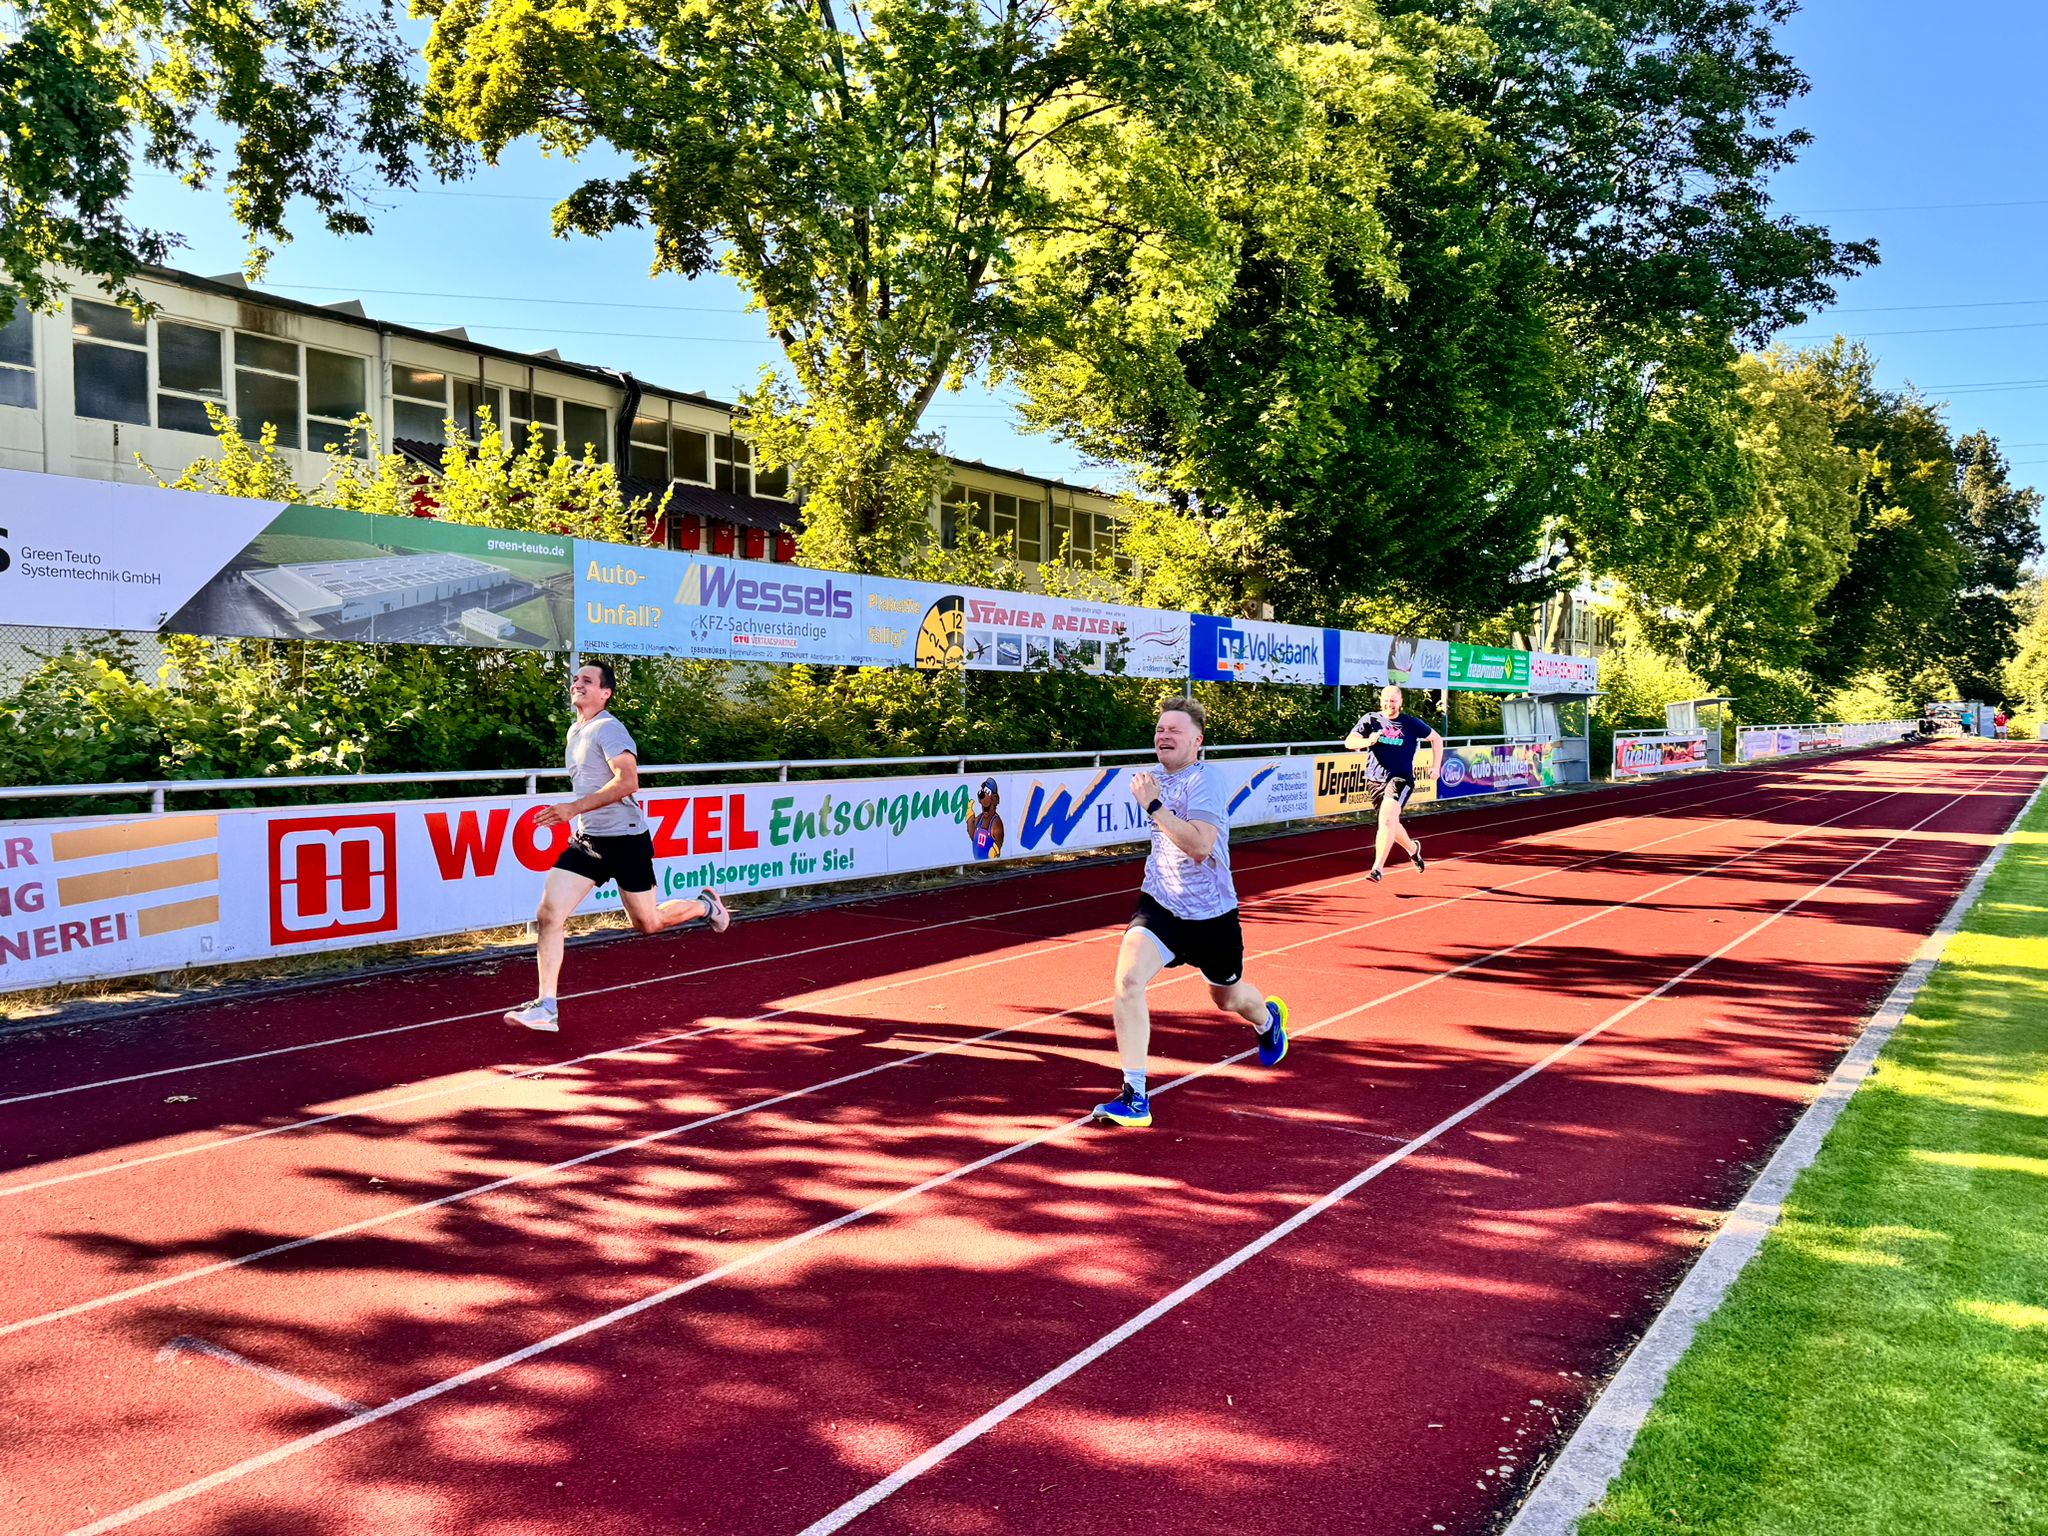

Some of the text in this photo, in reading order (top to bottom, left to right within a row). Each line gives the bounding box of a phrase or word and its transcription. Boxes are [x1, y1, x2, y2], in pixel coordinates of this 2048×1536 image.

[21, 546, 101, 565] Green Teuto
[487, 538, 565, 557] green-teuto.de
[21, 562, 161, 585] Systemtechnik GmbH
[586, 560, 646, 587] Auto-
[700, 564, 853, 619] Wessels
[868, 593, 921, 615] Plakette
[586, 601, 663, 628] Unfall?
[952, 612, 963, 629] 12
[967, 599, 1126, 635] STRIER REISEN
[700, 614, 827, 641] KFZ-Sachverständige
[584, 640, 609, 649] RHEINE
[751, 636, 797, 647] VERTRAGSPARTNER
[929, 633, 940, 648] 2
[1247, 632, 1319, 666] Volksbank
[925, 655, 936, 666] 3
[1471, 759, 1491, 779] auto
[1316, 761, 1369, 804] Vergöls
[769, 784, 969, 847] Entsorgung
[1096, 803, 1118, 833] H.
[663, 859, 784, 897] (ent)sorgen
[789, 851, 817, 875] für
[822, 847, 854, 872] Sie!
